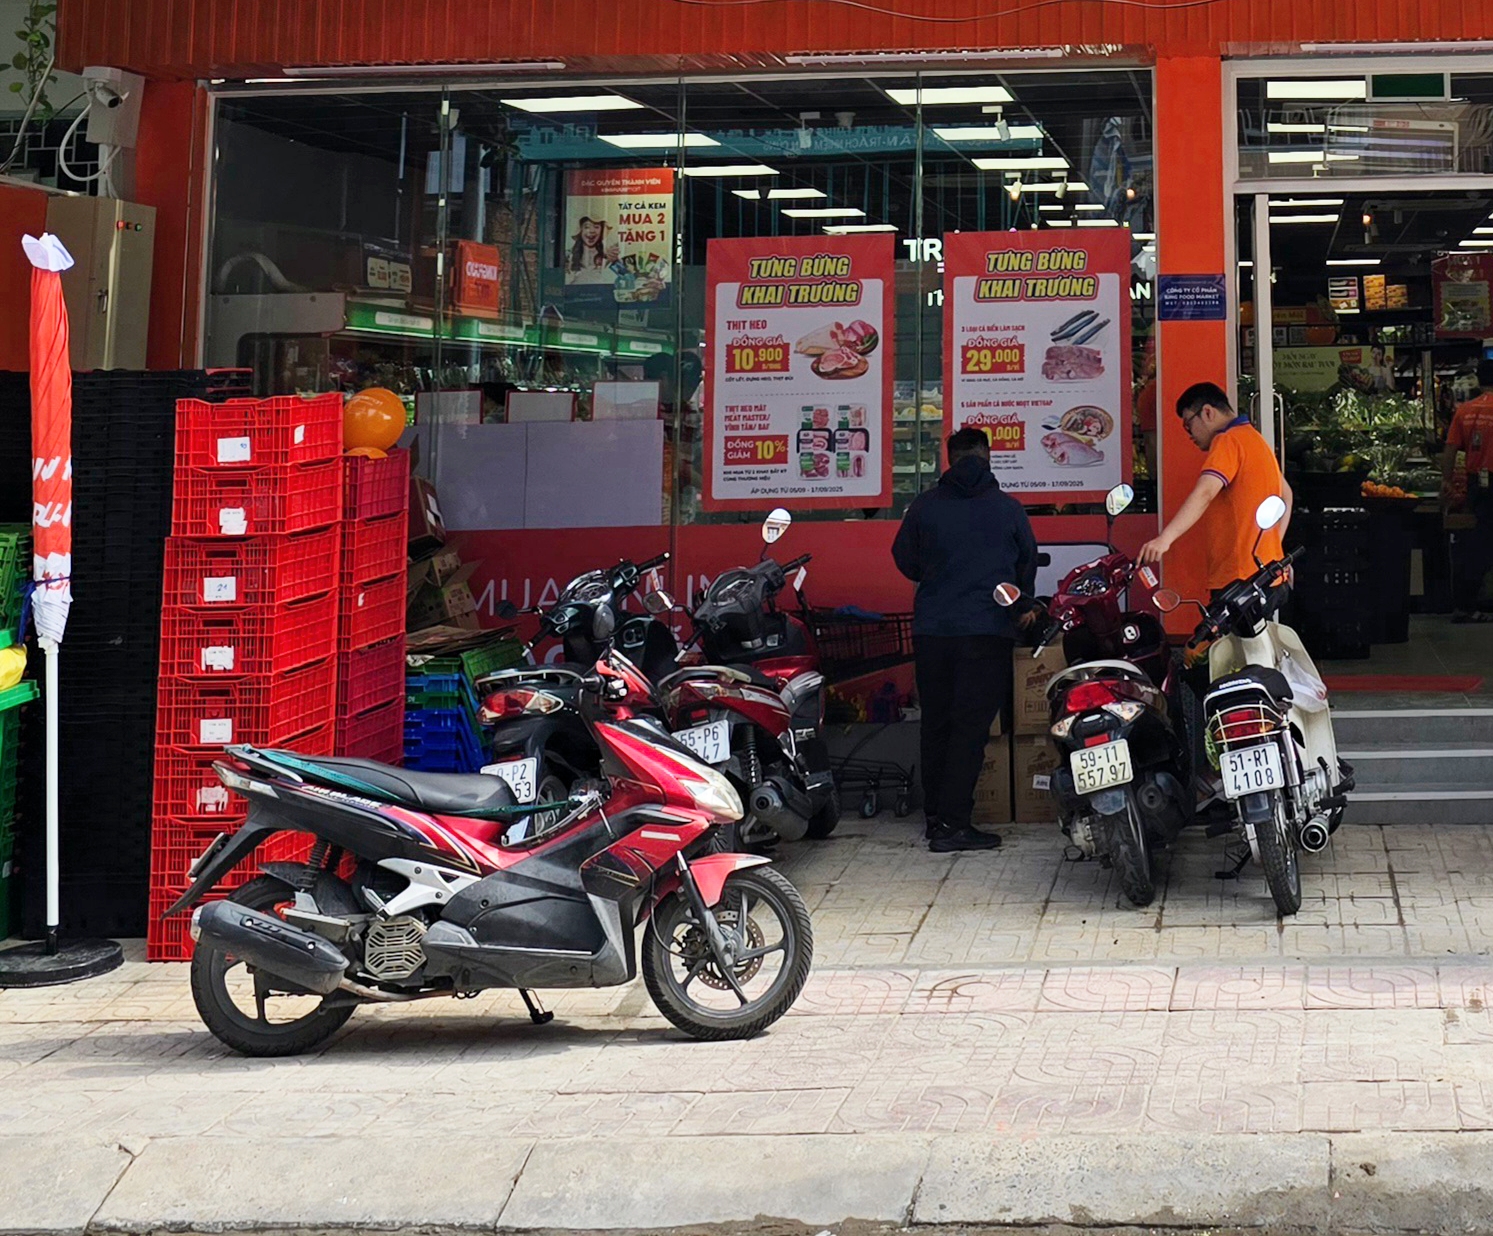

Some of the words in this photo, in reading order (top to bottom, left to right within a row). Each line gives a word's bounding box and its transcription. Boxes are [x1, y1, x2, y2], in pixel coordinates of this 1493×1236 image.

[648, 202, 666, 210] KEM
[619, 213, 653, 225] MUA
[657, 212, 665, 225] 2
[617, 228, 657, 245] TẶNG
[659, 230, 665, 242] 1
[740, 283, 785, 305] KHAI
[977, 278, 1022, 299] KHAI
[726, 320, 747, 333] THỊT
[749, 319, 767, 330] HEO
[766, 334, 785, 345] GIÁ
[1001, 335, 1019, 346] GIÁ
[732, 347, 784, 370] 10.900
[965, 348, 1020, 372] 29.000
[1000, 413, 1019, 424] GIÁ
[755, 440, 786, 460] 10%
[680, 725, 720, 747] 55-P6
[1080, 745, 1118, 769] 59-T1
[1229, 747, 1270, 773] 51-R1
[1078, 762, 1127, 790] 557.97
[1233, 768, 1275, 792] 4108
